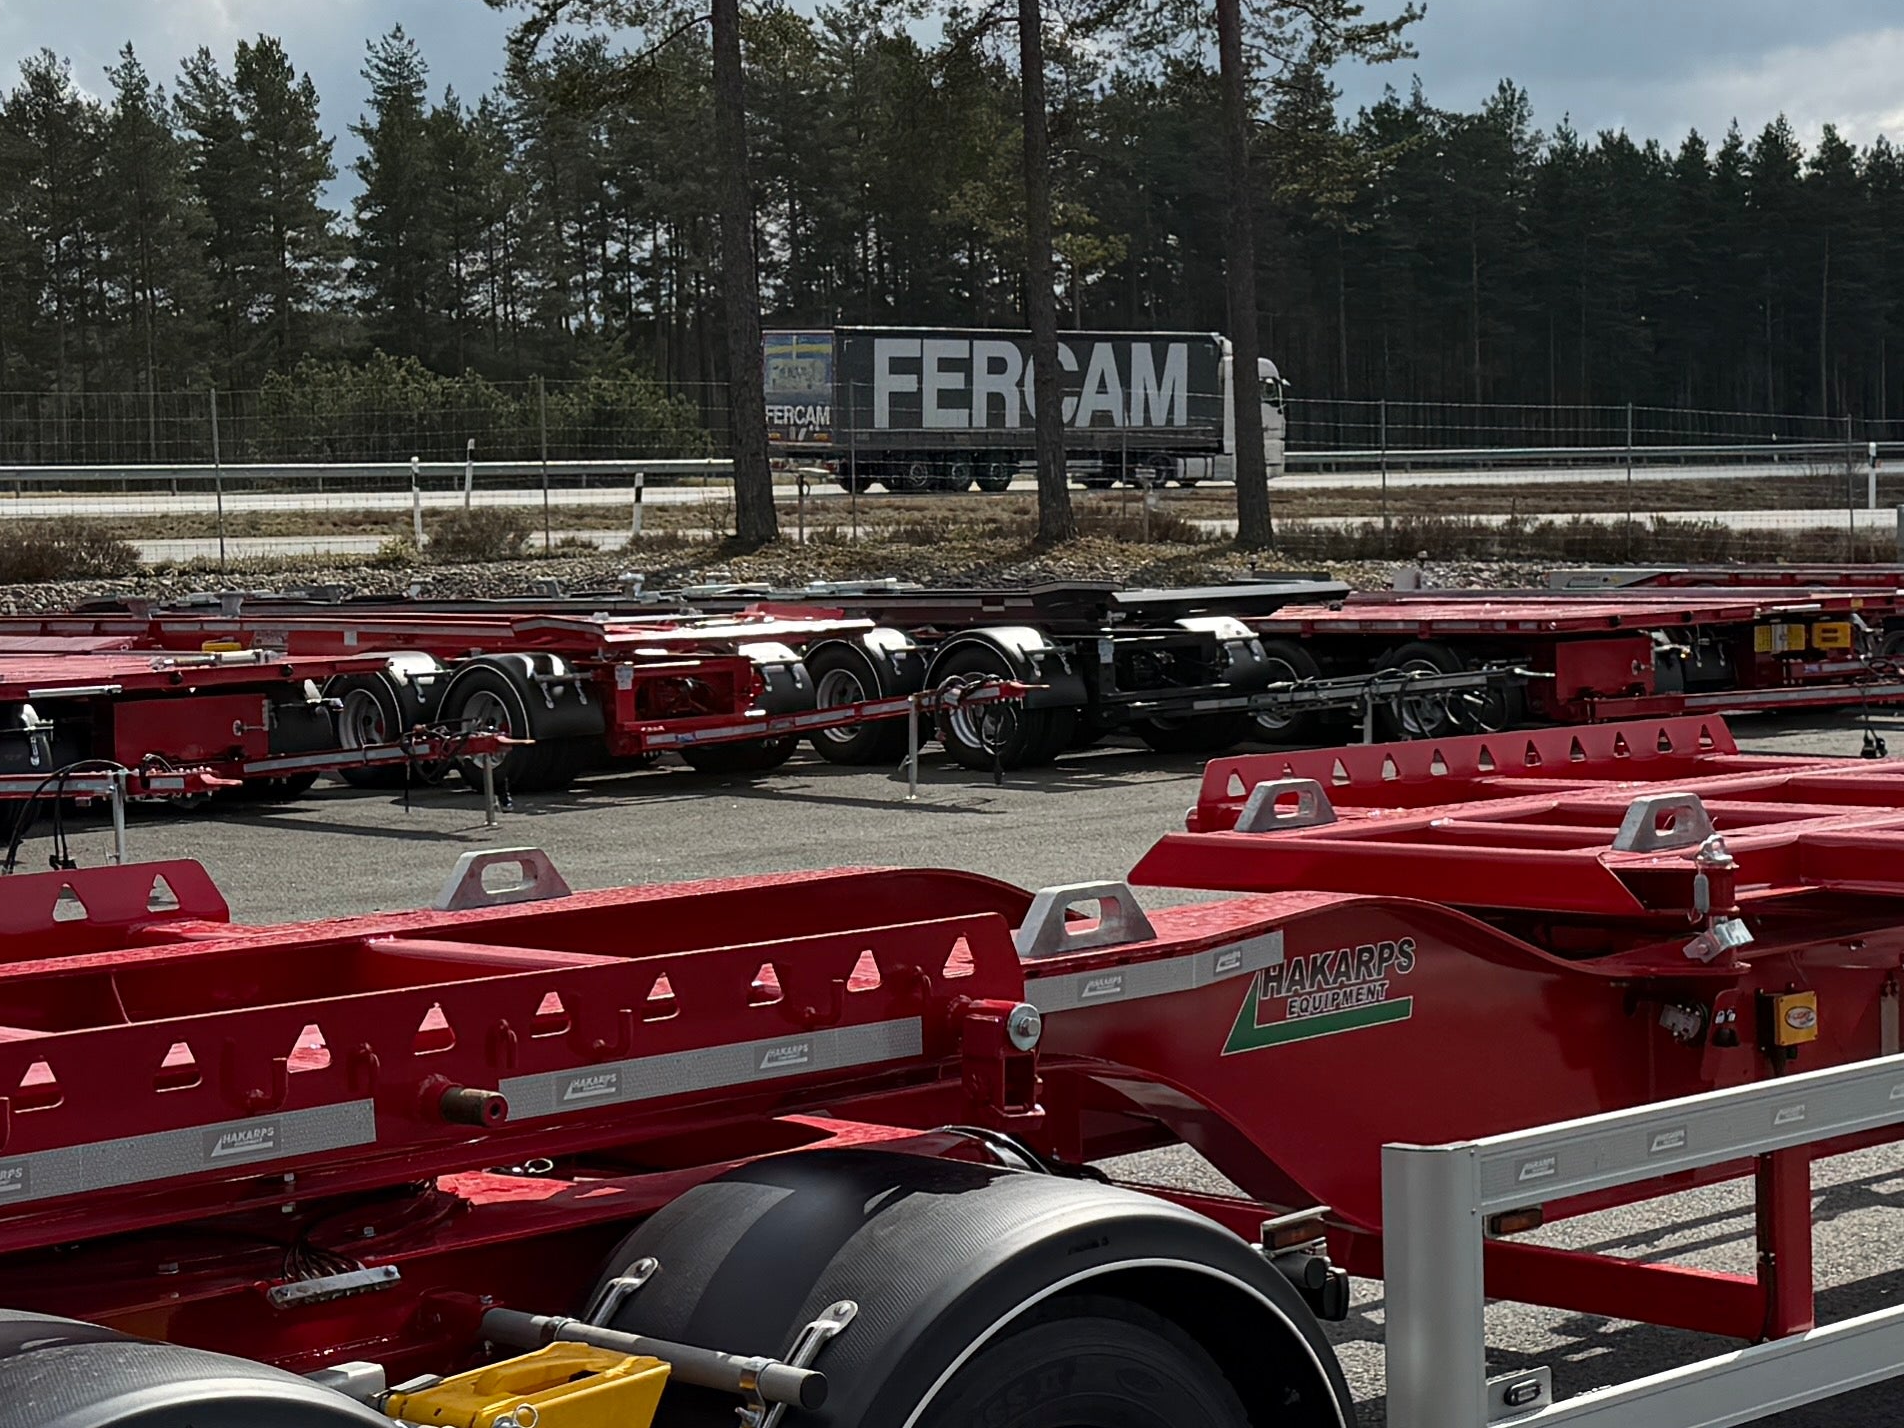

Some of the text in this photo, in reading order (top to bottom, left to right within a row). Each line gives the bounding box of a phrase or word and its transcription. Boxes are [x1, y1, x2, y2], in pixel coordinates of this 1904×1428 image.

[873, 338, 1188, 429] FERCAM
[765, 404, 831, 426] FERCAM
[1261, 937, 1416, 1000] HAKARPS
[1286, 980, 1390, 1018] EQUIPMENT
[222, 1127, 275, 1144] HAKARPS
